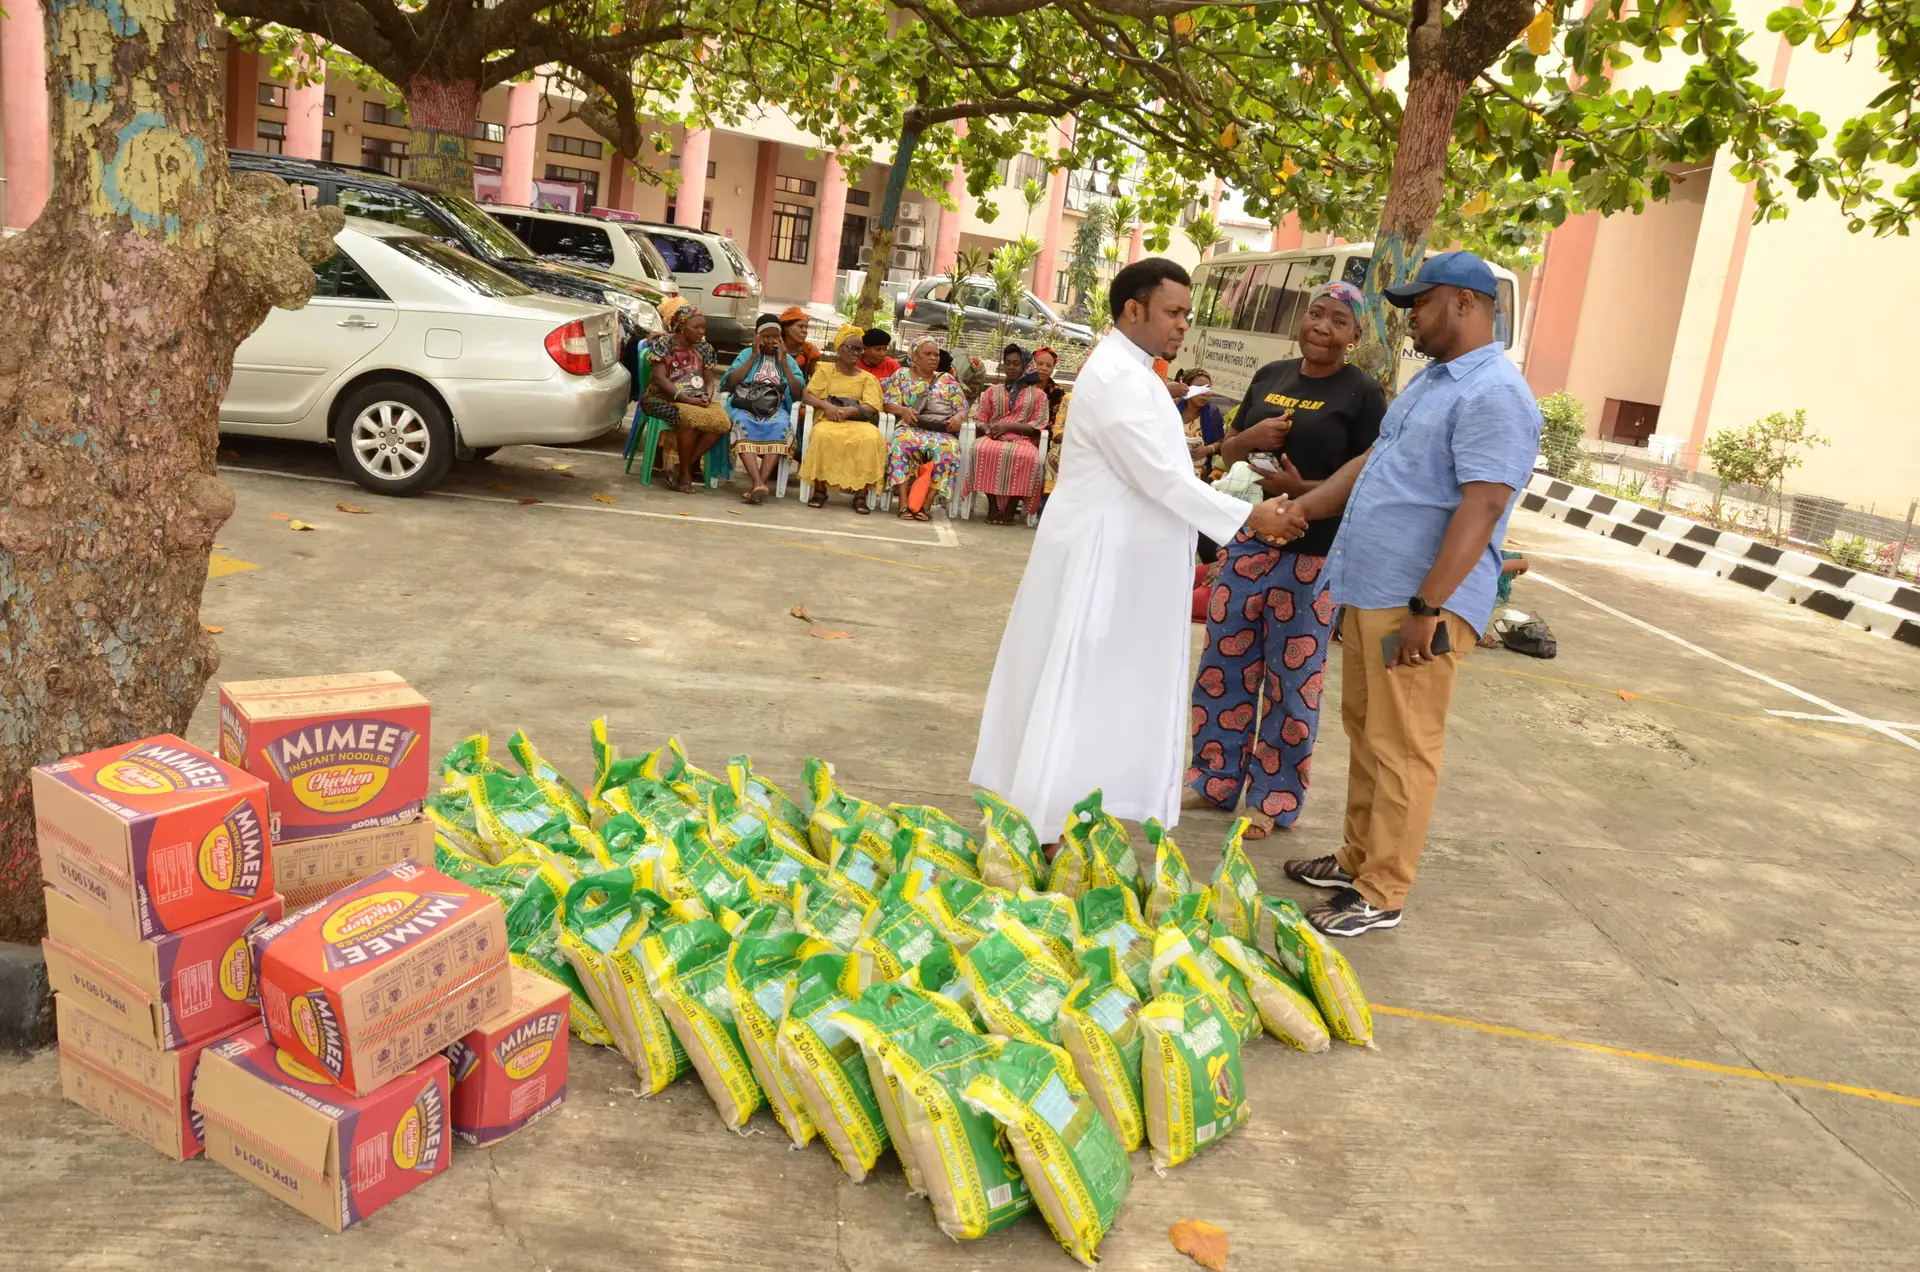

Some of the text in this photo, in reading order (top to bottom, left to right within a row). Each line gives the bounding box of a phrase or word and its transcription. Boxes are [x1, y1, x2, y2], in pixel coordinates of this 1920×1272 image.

[1205, 349, 1224, 361] CHRISTIAN
[1224, 352, 1243, 366] MOTHERS
[1208, 337, 1244, 351] CONFRATERNITY OF
[1299, 400, 1325, 410] SLAY
[282, 724, 400, 763] MIMEE
[138, 745, 223, 787] MIMEE
[289, 753, 390, 774] INSTANT NOODLES
[308, 769, 373, 791] Chicken
[322, 785, 359, 797] Flavour
[380, 815, 398, 826] SHA
[235, 809, 260, 887] MIMEE
[312, 842, 335, 852] CASES
[375, 830, 405, 841] MAXIMUM
[216, 836, 231, 881] Chicken
[228, 820, 241, 888] INSTANT NOODLES
[294, 847, 312, 855] HIGH
[61, 862, 107, 900] RPK19014
[392, 865, 416, 881] 40
[853, 887, 870, 906] Olam
[340, 899, 404, 935] Chicken
[395, 897, 431, 926] INSTANT
[335, 922, 394, 949] NOODLES
[341, 899, 460, 965] MIMEE
[449, 922, 477, 942] MAXIMUM
[235, 949, 248, 991] Chicken
[373, 972, 389, 985] HIGH
[390, 957, 411, 974] CASES
[880, 955, 894, 979] Olam
[74, 974, 127, 1014] RPK19014
[314, 998, 342, 1073] MIMEE
[501, 1014, 557, 1056] MIMEE
[643, 1020, 654, 1044] PRIDE
[746, 1013, 765, 1039] Olam
[1003, 1015, 1024, 1035] Olam
[392, 1059, 414, 1075] STORE
[430, 1038, 449, 1053] COOL
[449, 1031, 463, 1043] DRY
[463, 1016, 485, 1032] PLACE
[1162, 1037, 1174, 1063] Olam
[715, 1051, 730, 1073] PRIDE
[1085, 1027, 1100, 1053] Olam
[1111, 1086, 1124, 1110] PRIDE
[800, 1041, 820, 1070] Olam
[836, 1101, 853, 1126] PRIDE
[424, 1086, 442, 1162] MIMEE
[407, 1117, 418, 1159] Chicken
[924, 1091, 942, 1122] Olam
[951, 1163, 965, 1189] PRIDE
[234, 1145, 298, 1191] RPK19014
[1032, 1132, 1050, 1161] Olam
[1066, 1196, 1083, 1221] PRIDE
